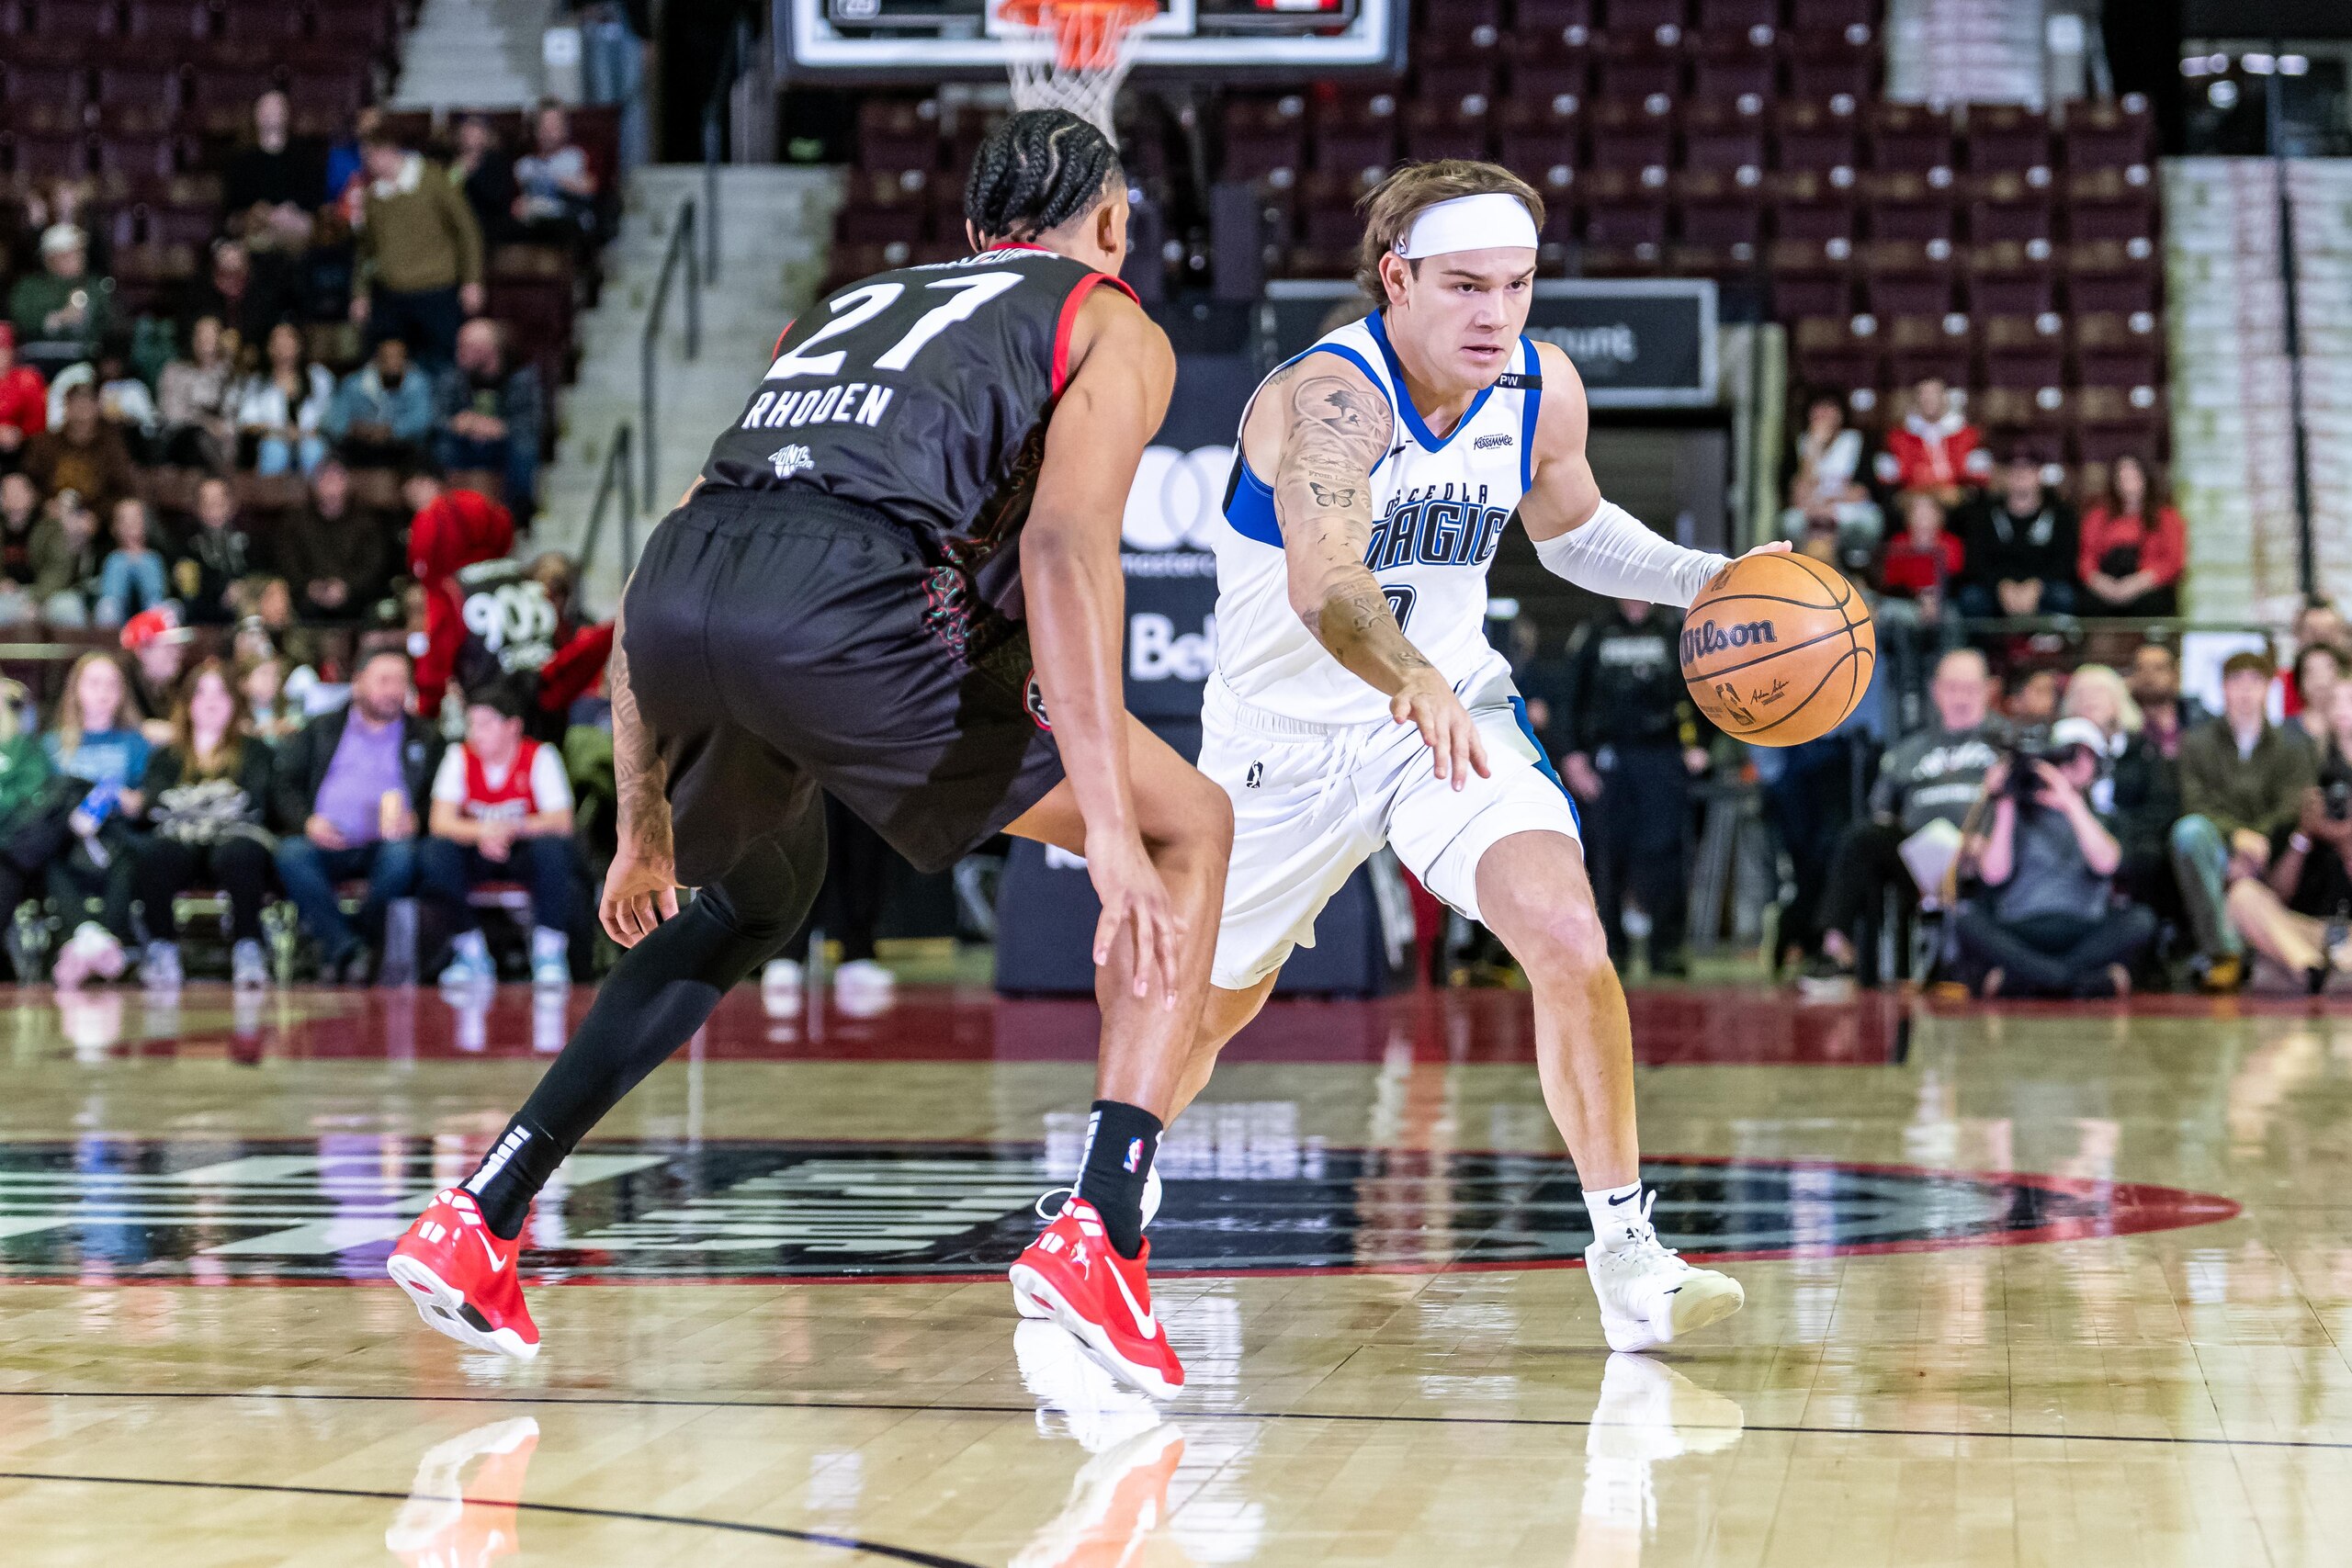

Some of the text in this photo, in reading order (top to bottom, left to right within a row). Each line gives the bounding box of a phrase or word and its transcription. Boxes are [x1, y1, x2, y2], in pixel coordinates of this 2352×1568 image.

[761, 272, 1025, 379] 27
[1499, 375, 1519, 386] PW
[741, 383, 895, 429] RHODEN
[1385, 482, 1488, 518] OSCEOLA
[1129, 613, 1218, 682] Bel
[1679, 619, 1777, 668] Wilson
